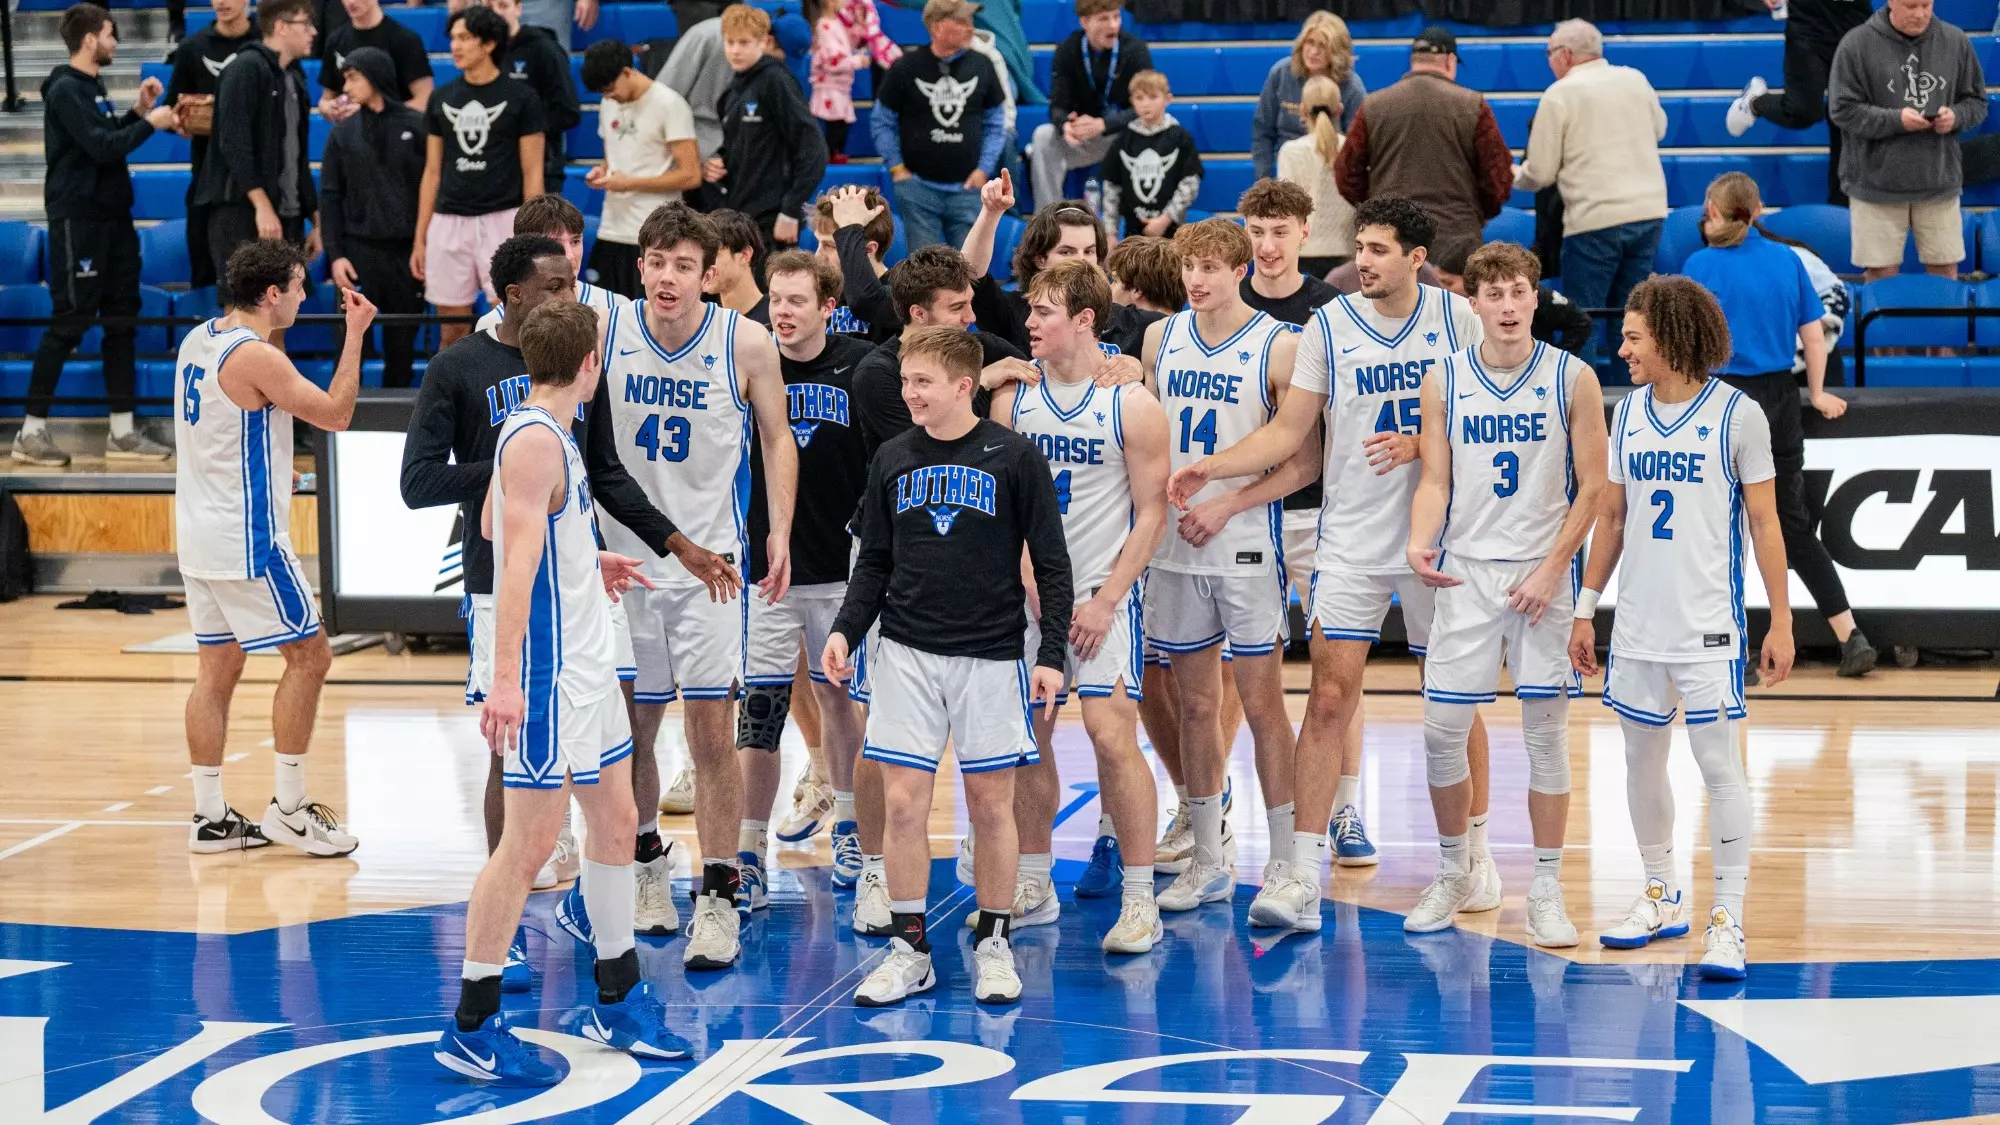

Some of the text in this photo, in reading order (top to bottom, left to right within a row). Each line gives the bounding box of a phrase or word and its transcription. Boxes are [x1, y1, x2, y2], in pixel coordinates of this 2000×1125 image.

[183, 363, 205, 426] 15
[624, 374, 709, 410] NORSE
[785, 383, 850, 427] THER
[1168, 370, 1243, 404] NORSE
[635, 414, 691, 462] 43
[1179, 406, 1218, 455] 14
[1375, 397, 1422, 436] 45
[1463, 413, 1547, 444] NORSE
[1492, 451, 1519, 498] 3
[1628, 451, 1706, 483] NORSE
[896, 464, 997, 517] LUTHER
[935, 514, 953, 522] NORSE
[1650, 489, 1674, 540] 2
